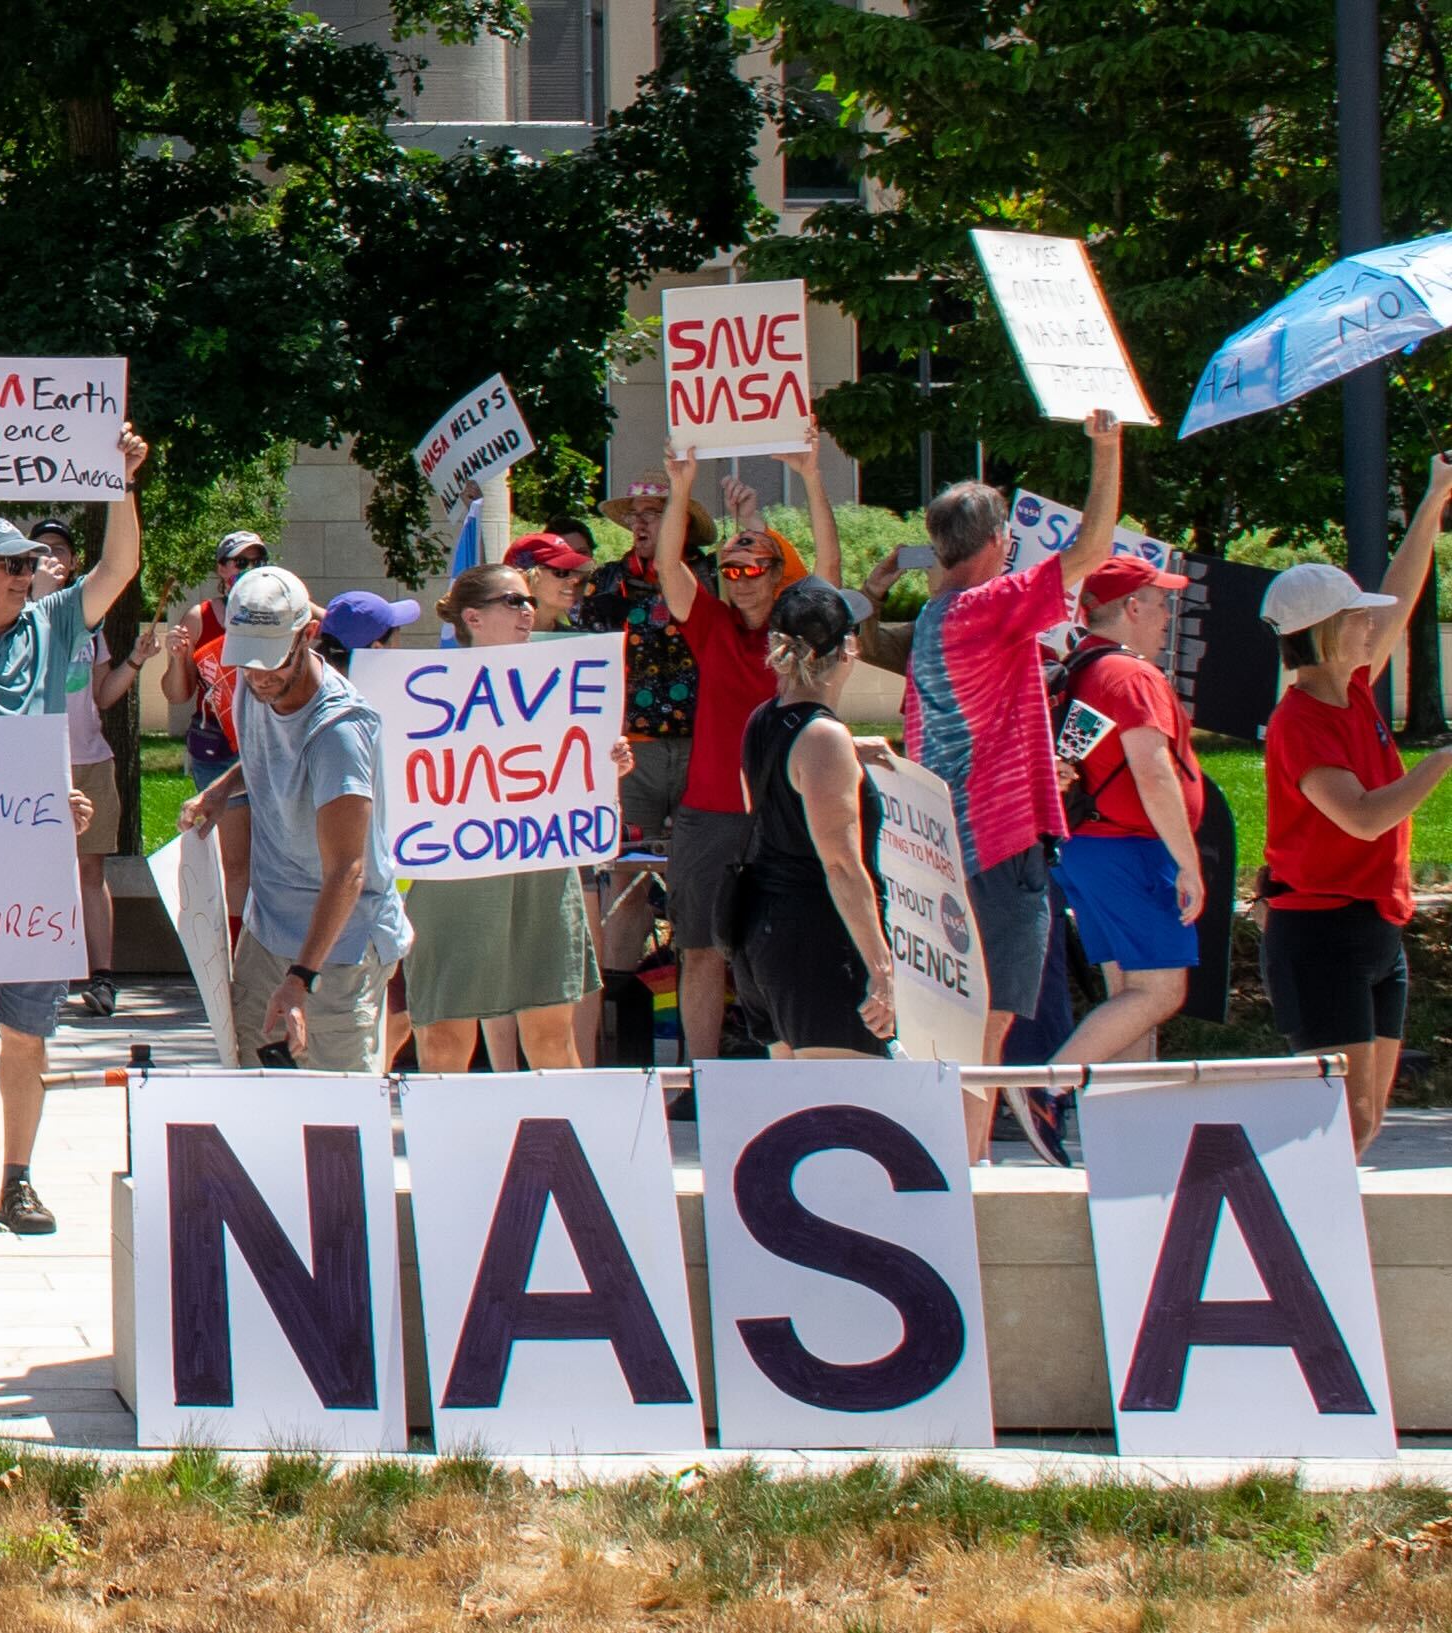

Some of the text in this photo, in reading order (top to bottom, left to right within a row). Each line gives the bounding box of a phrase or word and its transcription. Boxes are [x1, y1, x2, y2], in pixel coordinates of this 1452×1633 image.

[668, 314, 803, 371] SAVE
[1339, 290, 1401, 345] NO
[33, 377, 117, 414] Earth
[670, 371, 808, 427] NASA
[420, 386, 508, 478] NASA HELPS
[60, 458, 125, 491] America
[439, 428, 521, 515] ALL MANKIND
[1017, 504, 1041, 517] NASA
[404, 659, 610, 740] SAVE
[405, 725, 595, 806] NASA
[393, 805, 618, 866] GODDARD
[909, 841, 924, 862] TO
